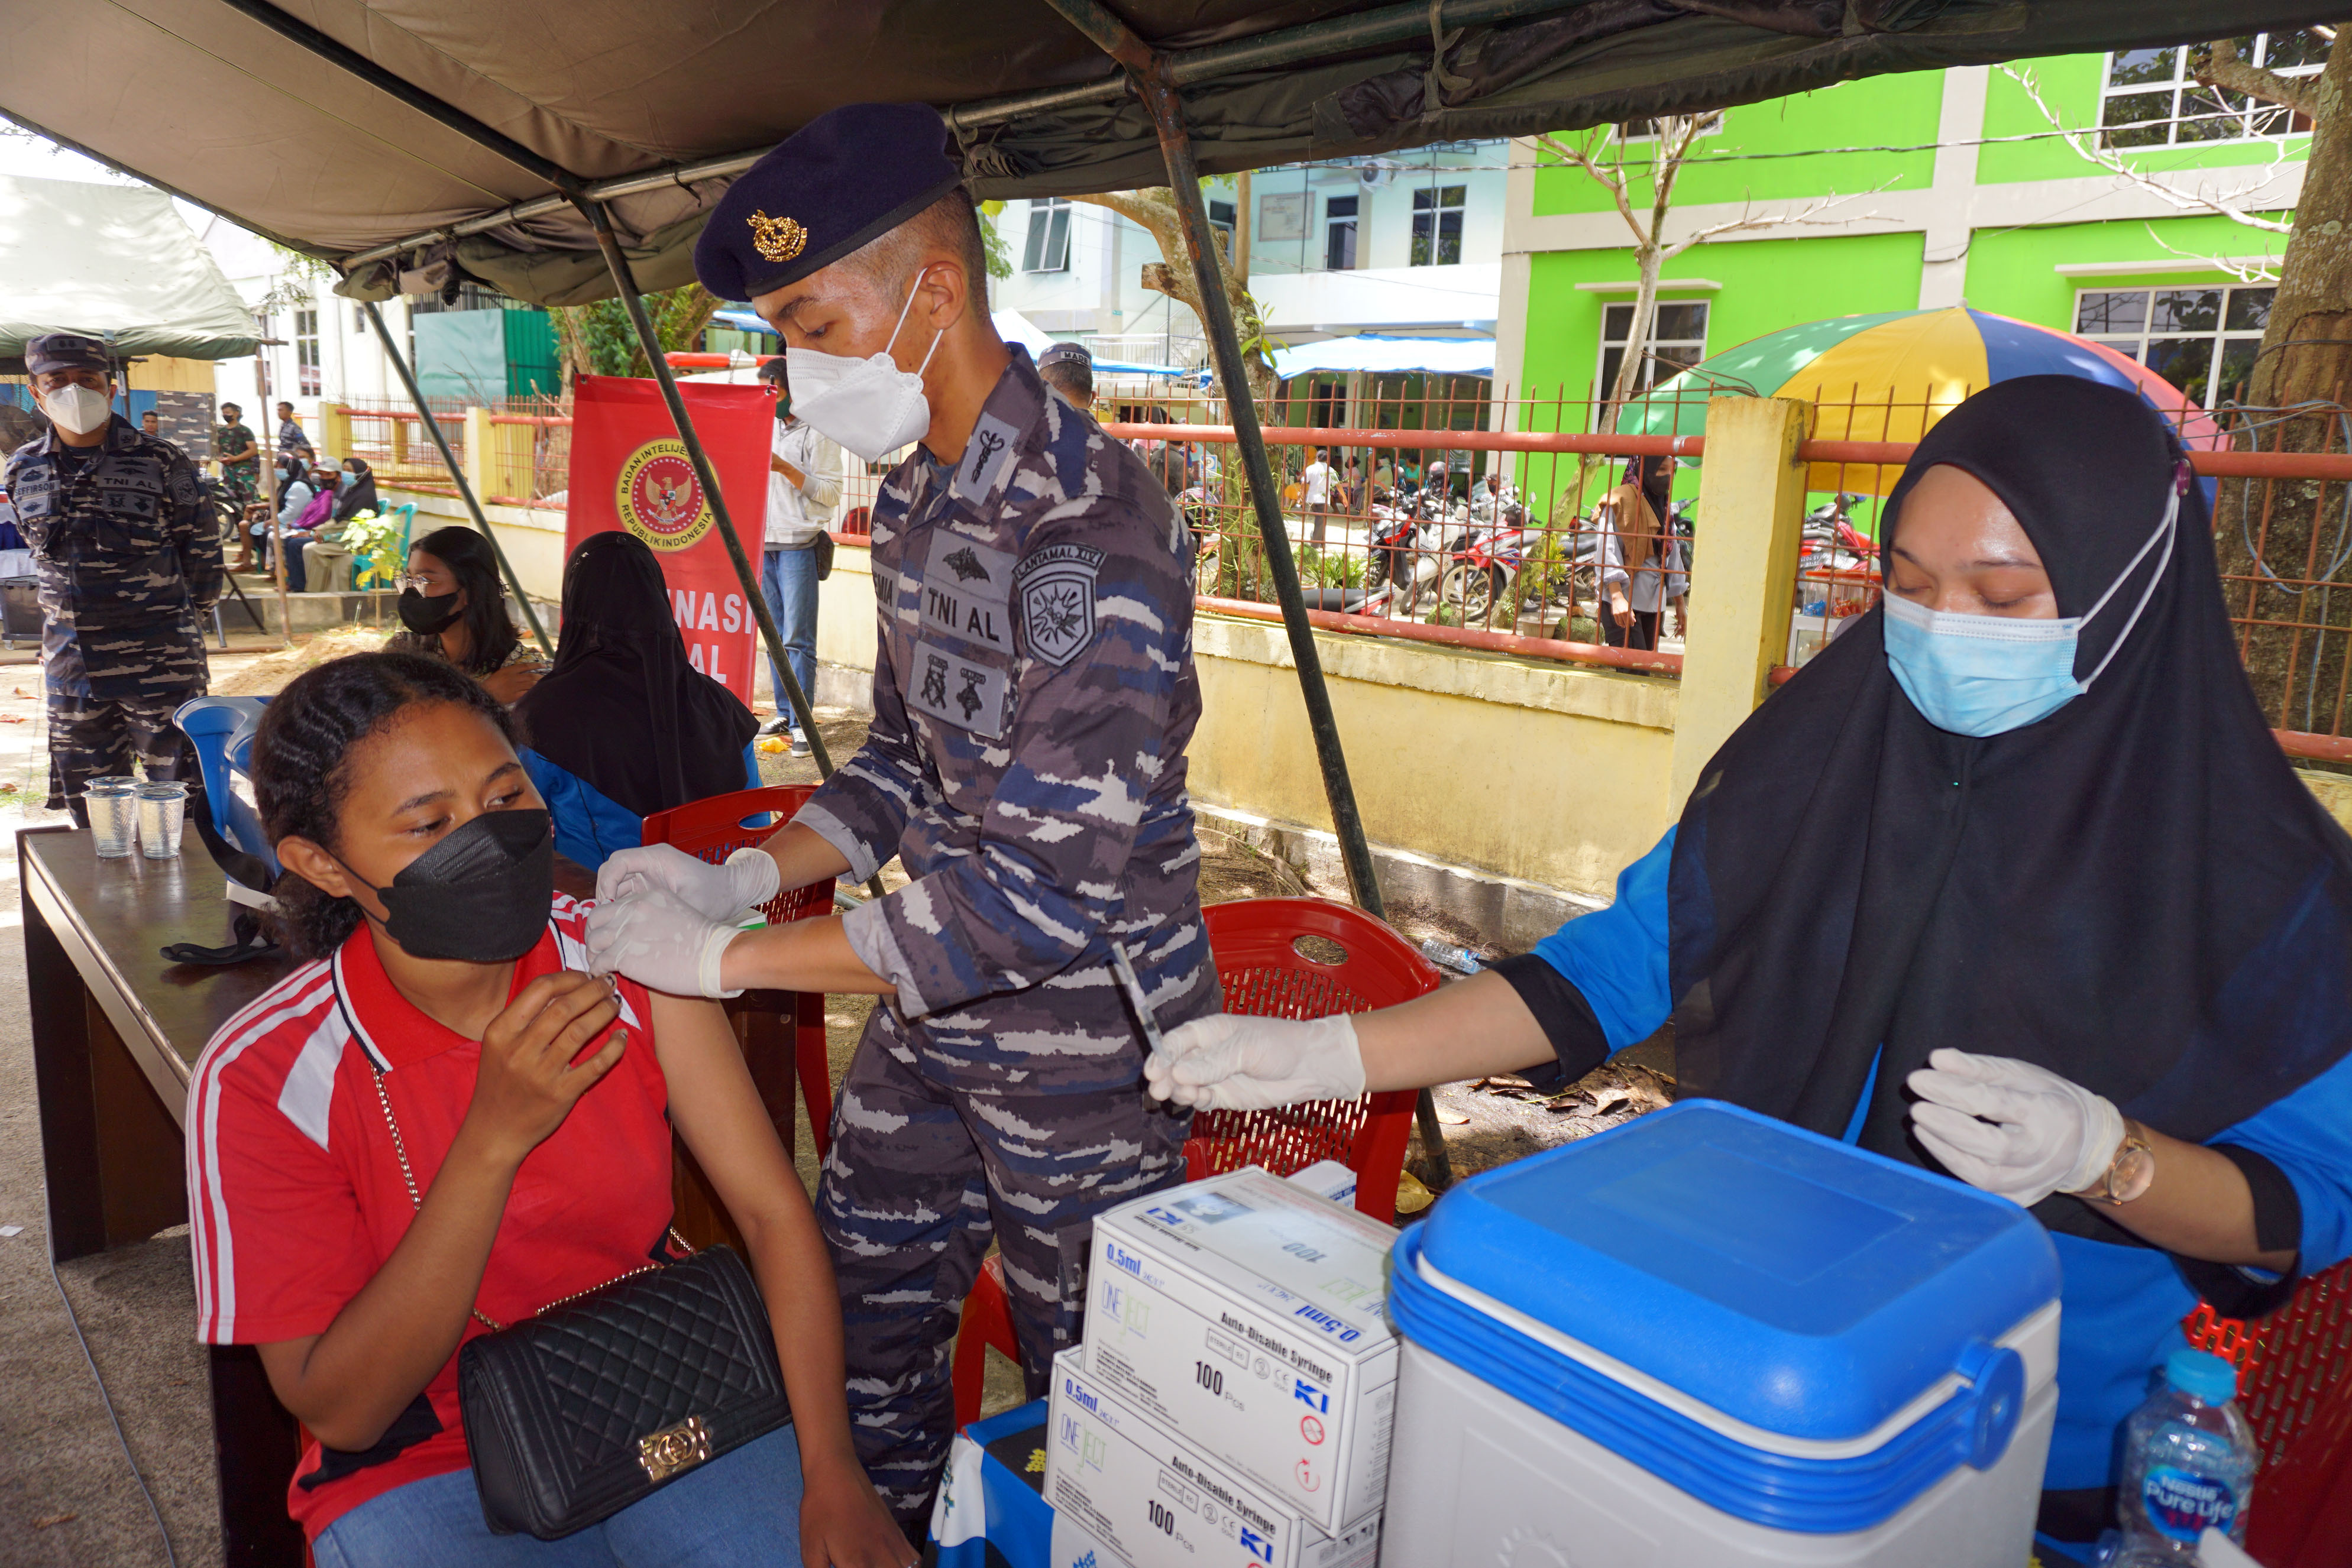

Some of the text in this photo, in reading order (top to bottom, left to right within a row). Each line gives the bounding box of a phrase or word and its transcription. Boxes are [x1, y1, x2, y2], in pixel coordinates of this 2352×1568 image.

[1065, 352, 1089, 364] MADE
[104, 477, 156, 490] TNI AL
[622, 444, 688, 494] BADAN INTELIJE
[622, 504, 713, 547] REPUBLIK INDONESIA
[1018, 546, 1098, 575] LANTAMAL XIV
[928, 587, 1001, 643] TNI AL
[1107, 1243, 1141, 1276] 0.5ml
[1282, 1243, 1327, 1264] 100
[1102, 1280, 1123, 1318] ONE
[1295, 1304, 1361, 1343] 0.5ml
[1221, 1311, 1333, 1384] Auto-Disable Syringe
[1066, 1379, 1098, 1412] 0.5ml
[1196, 1360, 1223, 1396] 100
[1295, 1378, 1329, 1415] KI
[1060, 1414, 1081, 1449] ONE
[1172, 1455, 1234, 1507] Auto-Disable
[1237, 1498, 1276, 1535] Syringe
[2147, 1480, 2234, 1524] Pure Life
[1148, 1499, 1174, 1537] 100
[1240, 1526, 1274, 1564] KI
